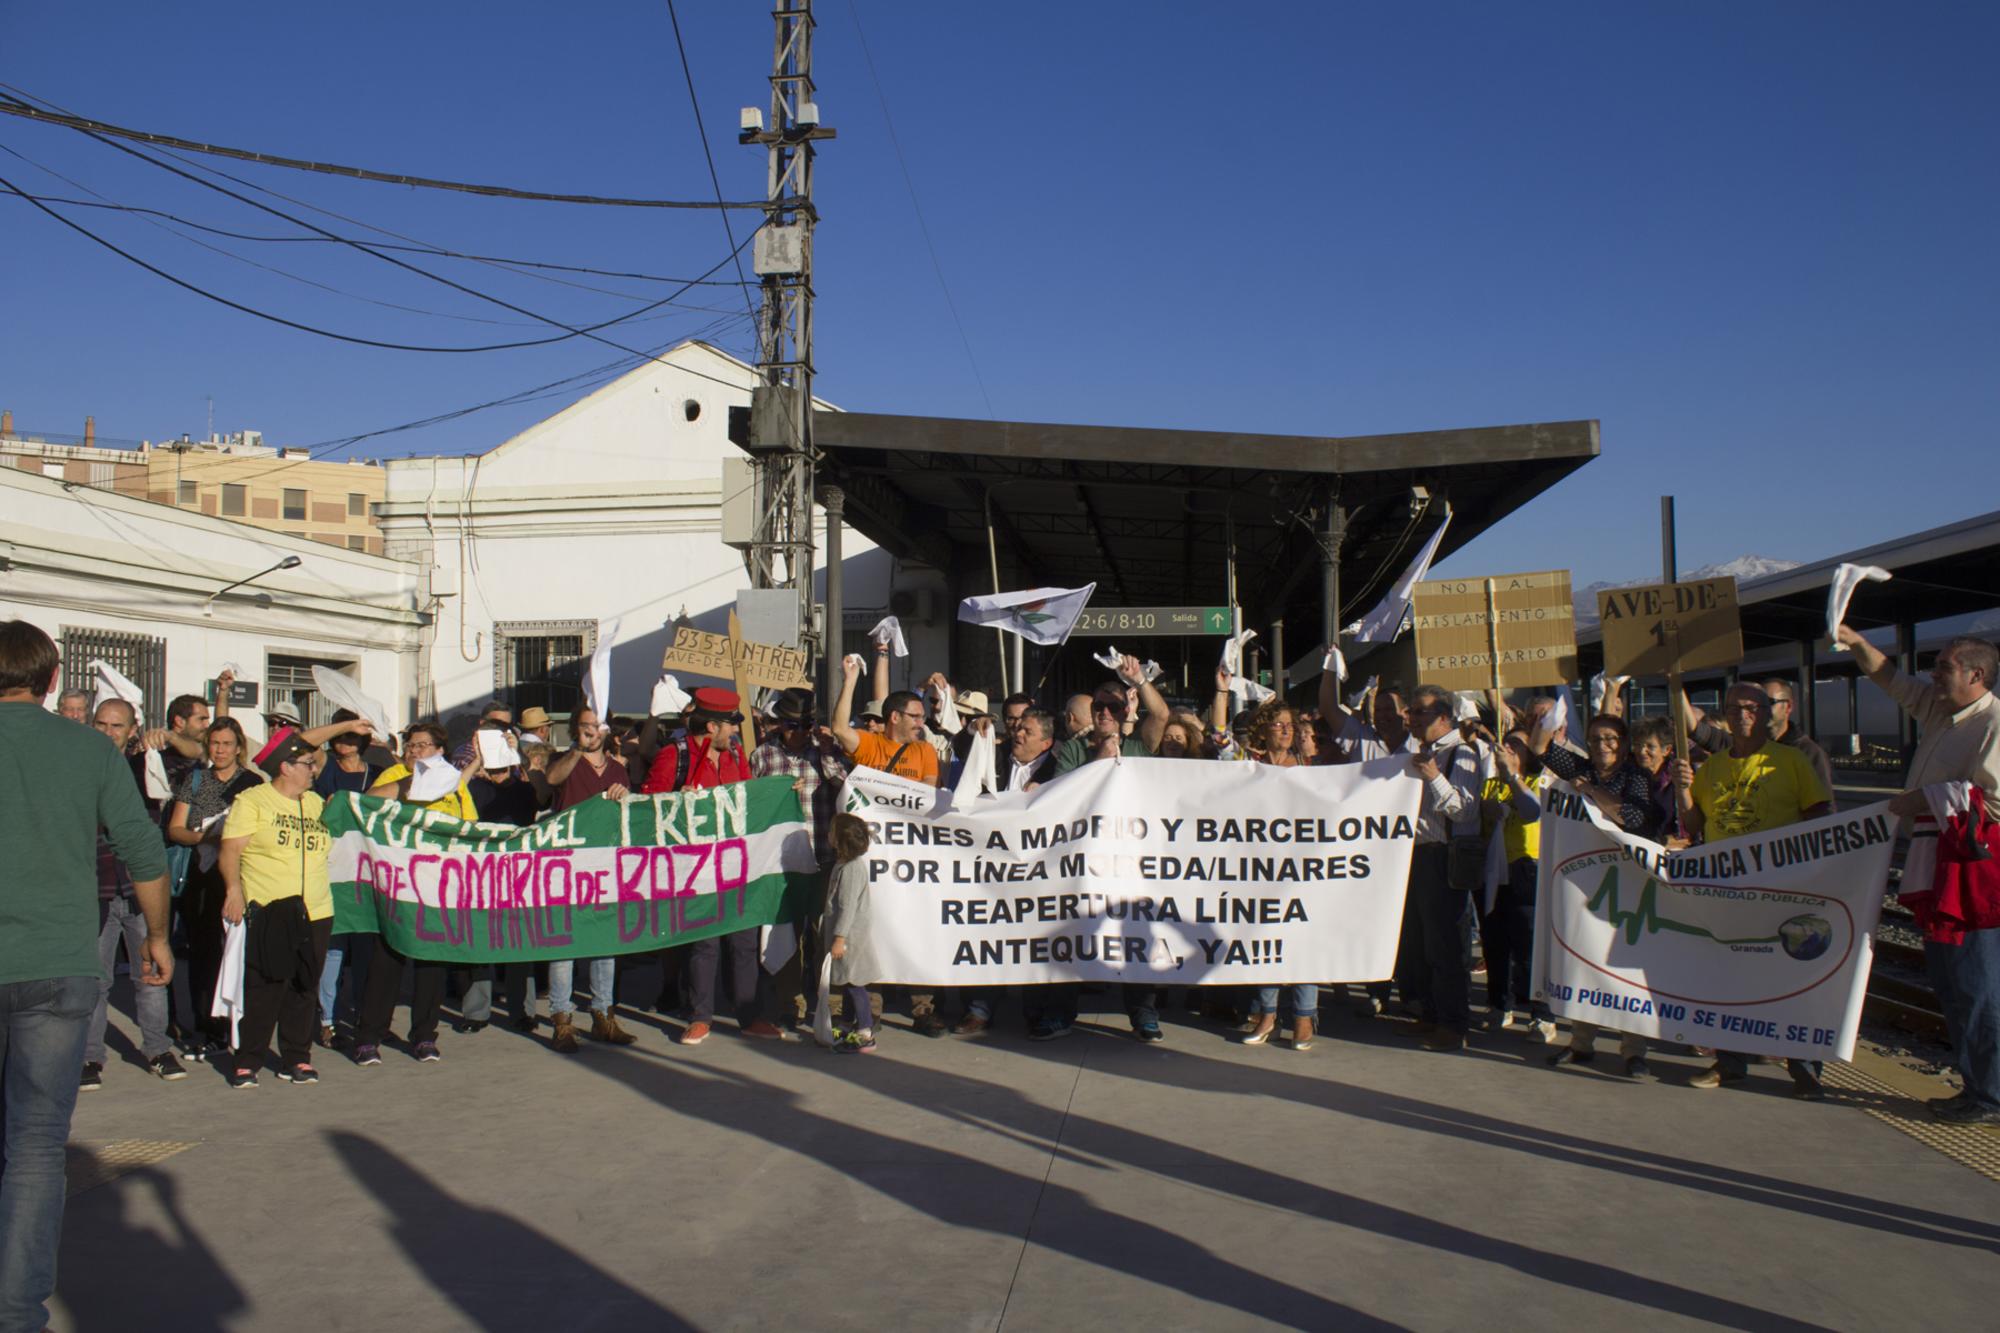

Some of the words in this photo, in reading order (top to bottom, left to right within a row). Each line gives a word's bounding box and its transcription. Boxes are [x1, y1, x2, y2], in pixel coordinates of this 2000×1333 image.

[1441, 582, 1467, 594] NO
[1508, 578, 1534, 591] AL
[1172, 613, 1198, 622] Salida
[1427, 648, 1547, 671] FERROVARIO
[601, 782, 749, 847] TREN
[874, 793, 925, 810] adif
[866, 821, 975, 847] RENES
[985, 830, 1010, 852] A
[1160, 818, 1184, 842] Y
[1196, 815, 1415, 843] BARCELONA
[869, 858, 941, 884] POR
[952, 854, 1049, 885] LÍNEA
[1654, 847, 1747, 880] PÚBLICA
[1750, 843, 1763, 872] Y
[409, 848, 574, 950] COMARCA
[575, 869, 610, 912] DE
[616, 837, 749, 944] BAZA
[941, 893, 1182, 925] REAPERTURA
[1195, 891, 1309, 925] LÍNEA
[1692, 886, 1757, 901] SANIDAD
[952, 927, 1184, 970] ANTEQUERA,
[1197, 938, 1283, 966] YA!!!
[1577, 987, 1652, 1016] PÚBLICA
[1658, 1002, 1686, 1021] NO
[1693, 1009, 1717, 1028] SE
[1721, 1014, 1781, 1041] VENDE,
[1785, 1024, 1809, 1043] SE
[1812, 1027, 1836, 1046] DE
